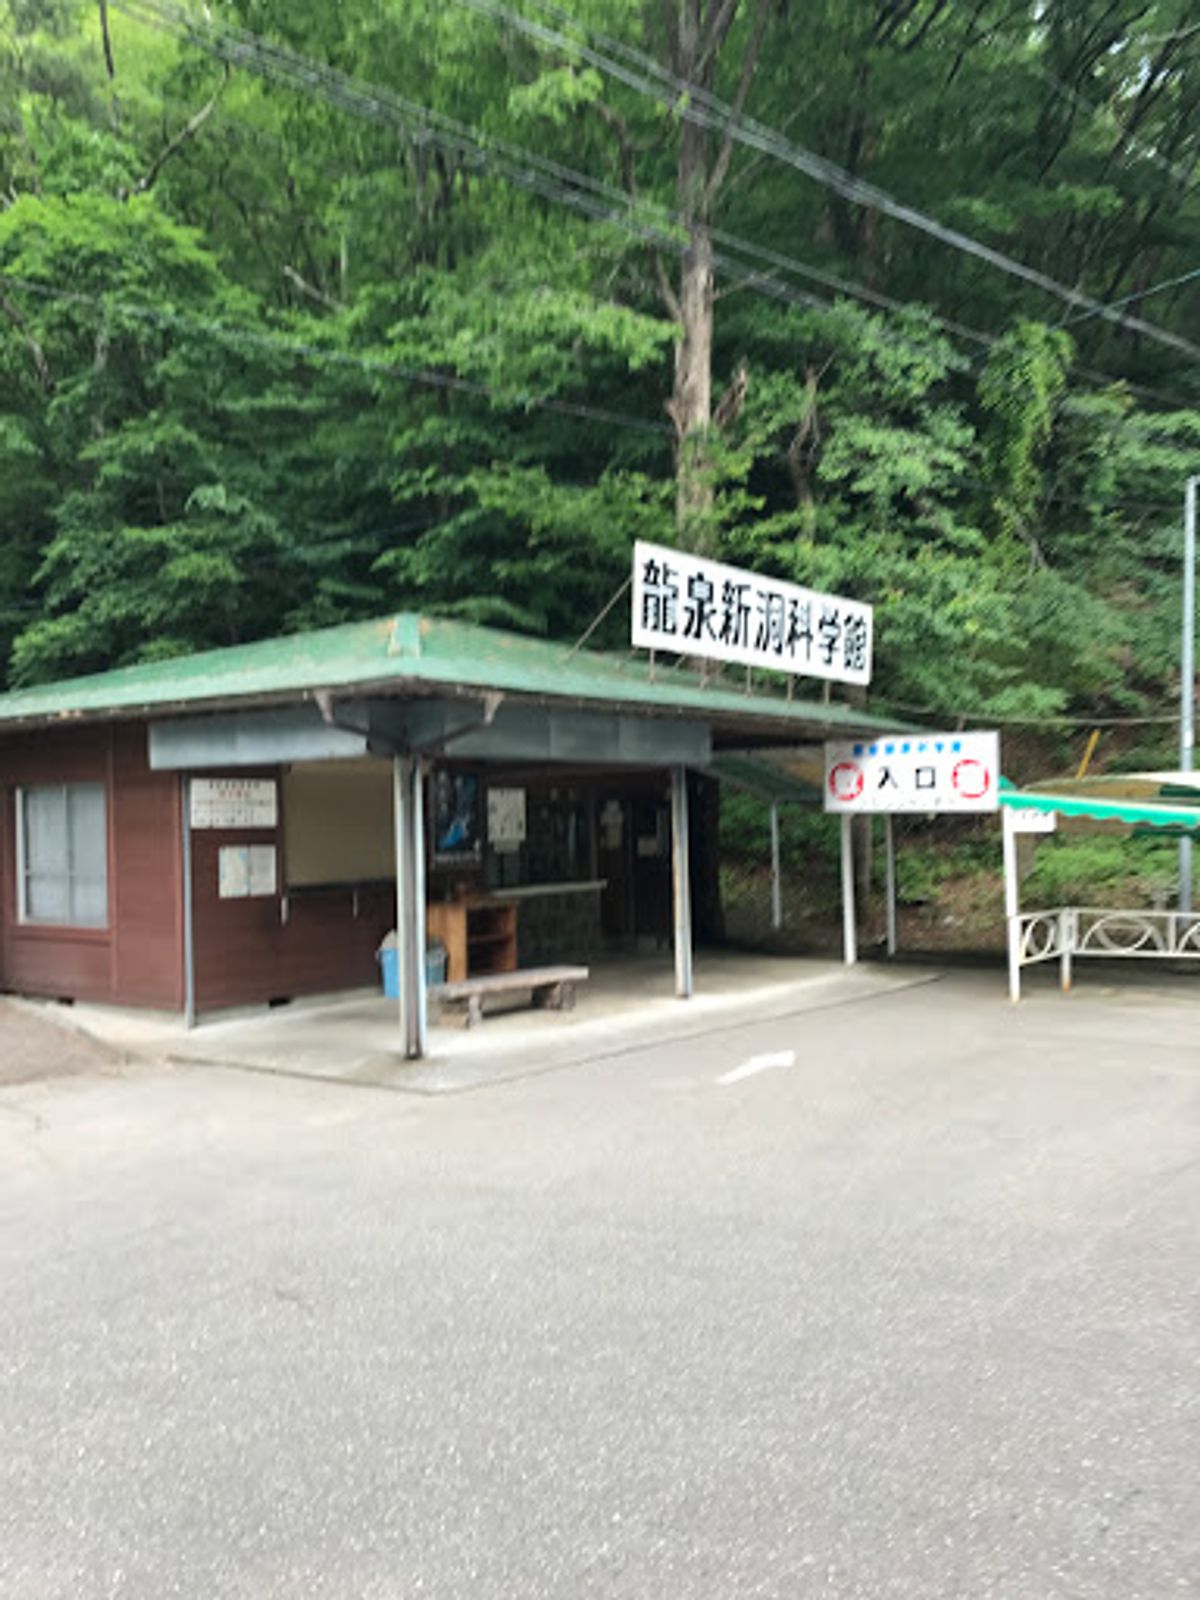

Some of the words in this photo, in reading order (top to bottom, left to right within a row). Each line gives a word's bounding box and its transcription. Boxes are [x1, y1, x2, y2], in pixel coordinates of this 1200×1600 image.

[642, 558, 867, 671] 龍泉新洞科学館
[878, 766, 936, 789] 入口
